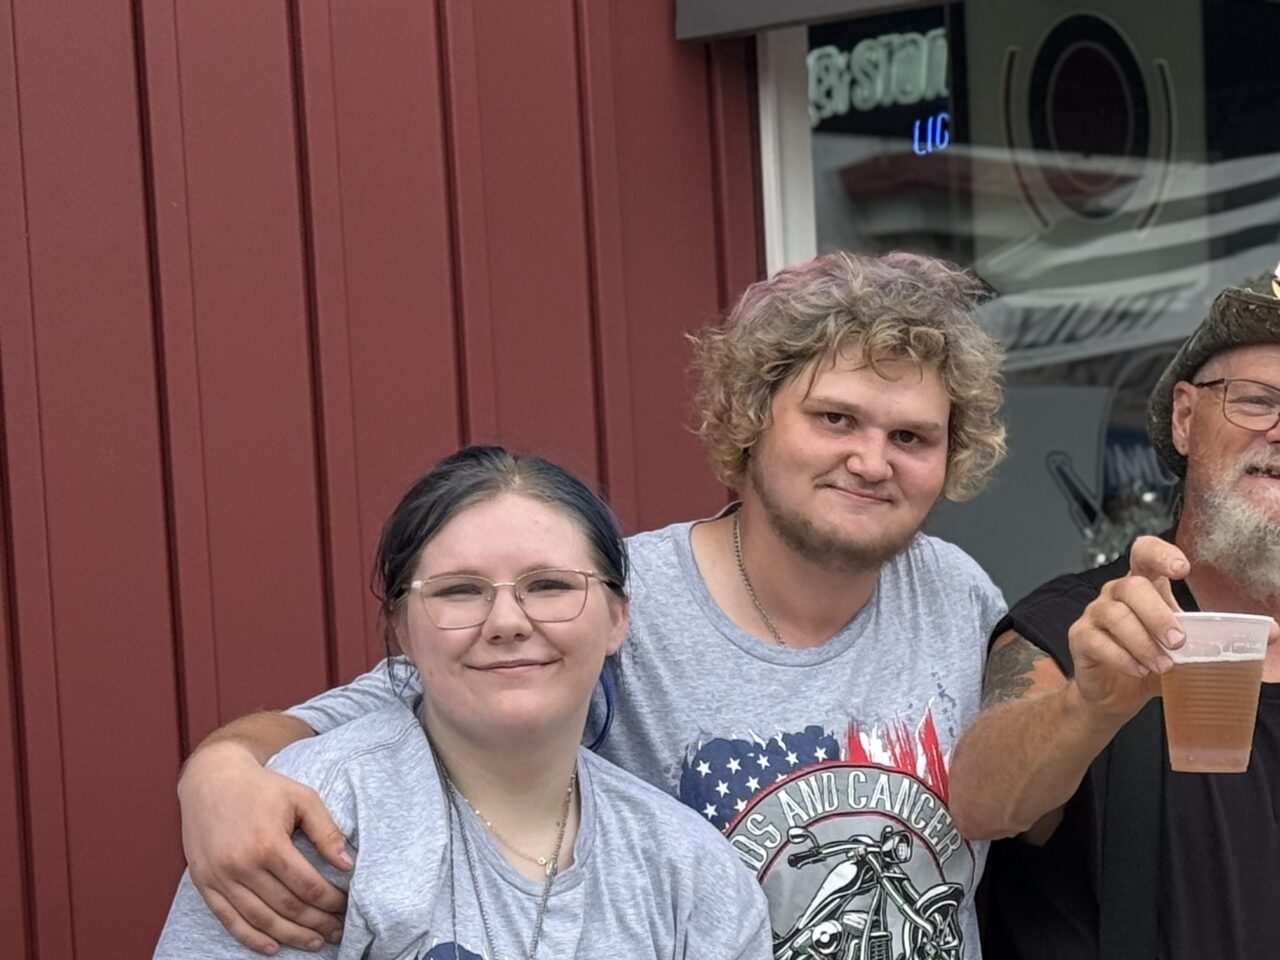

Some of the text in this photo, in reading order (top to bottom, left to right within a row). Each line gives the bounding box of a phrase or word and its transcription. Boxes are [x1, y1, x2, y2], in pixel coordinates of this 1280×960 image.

[912, 112, 949, 155] LIG
[729, 770, 962, 873] DS AND CANCER
